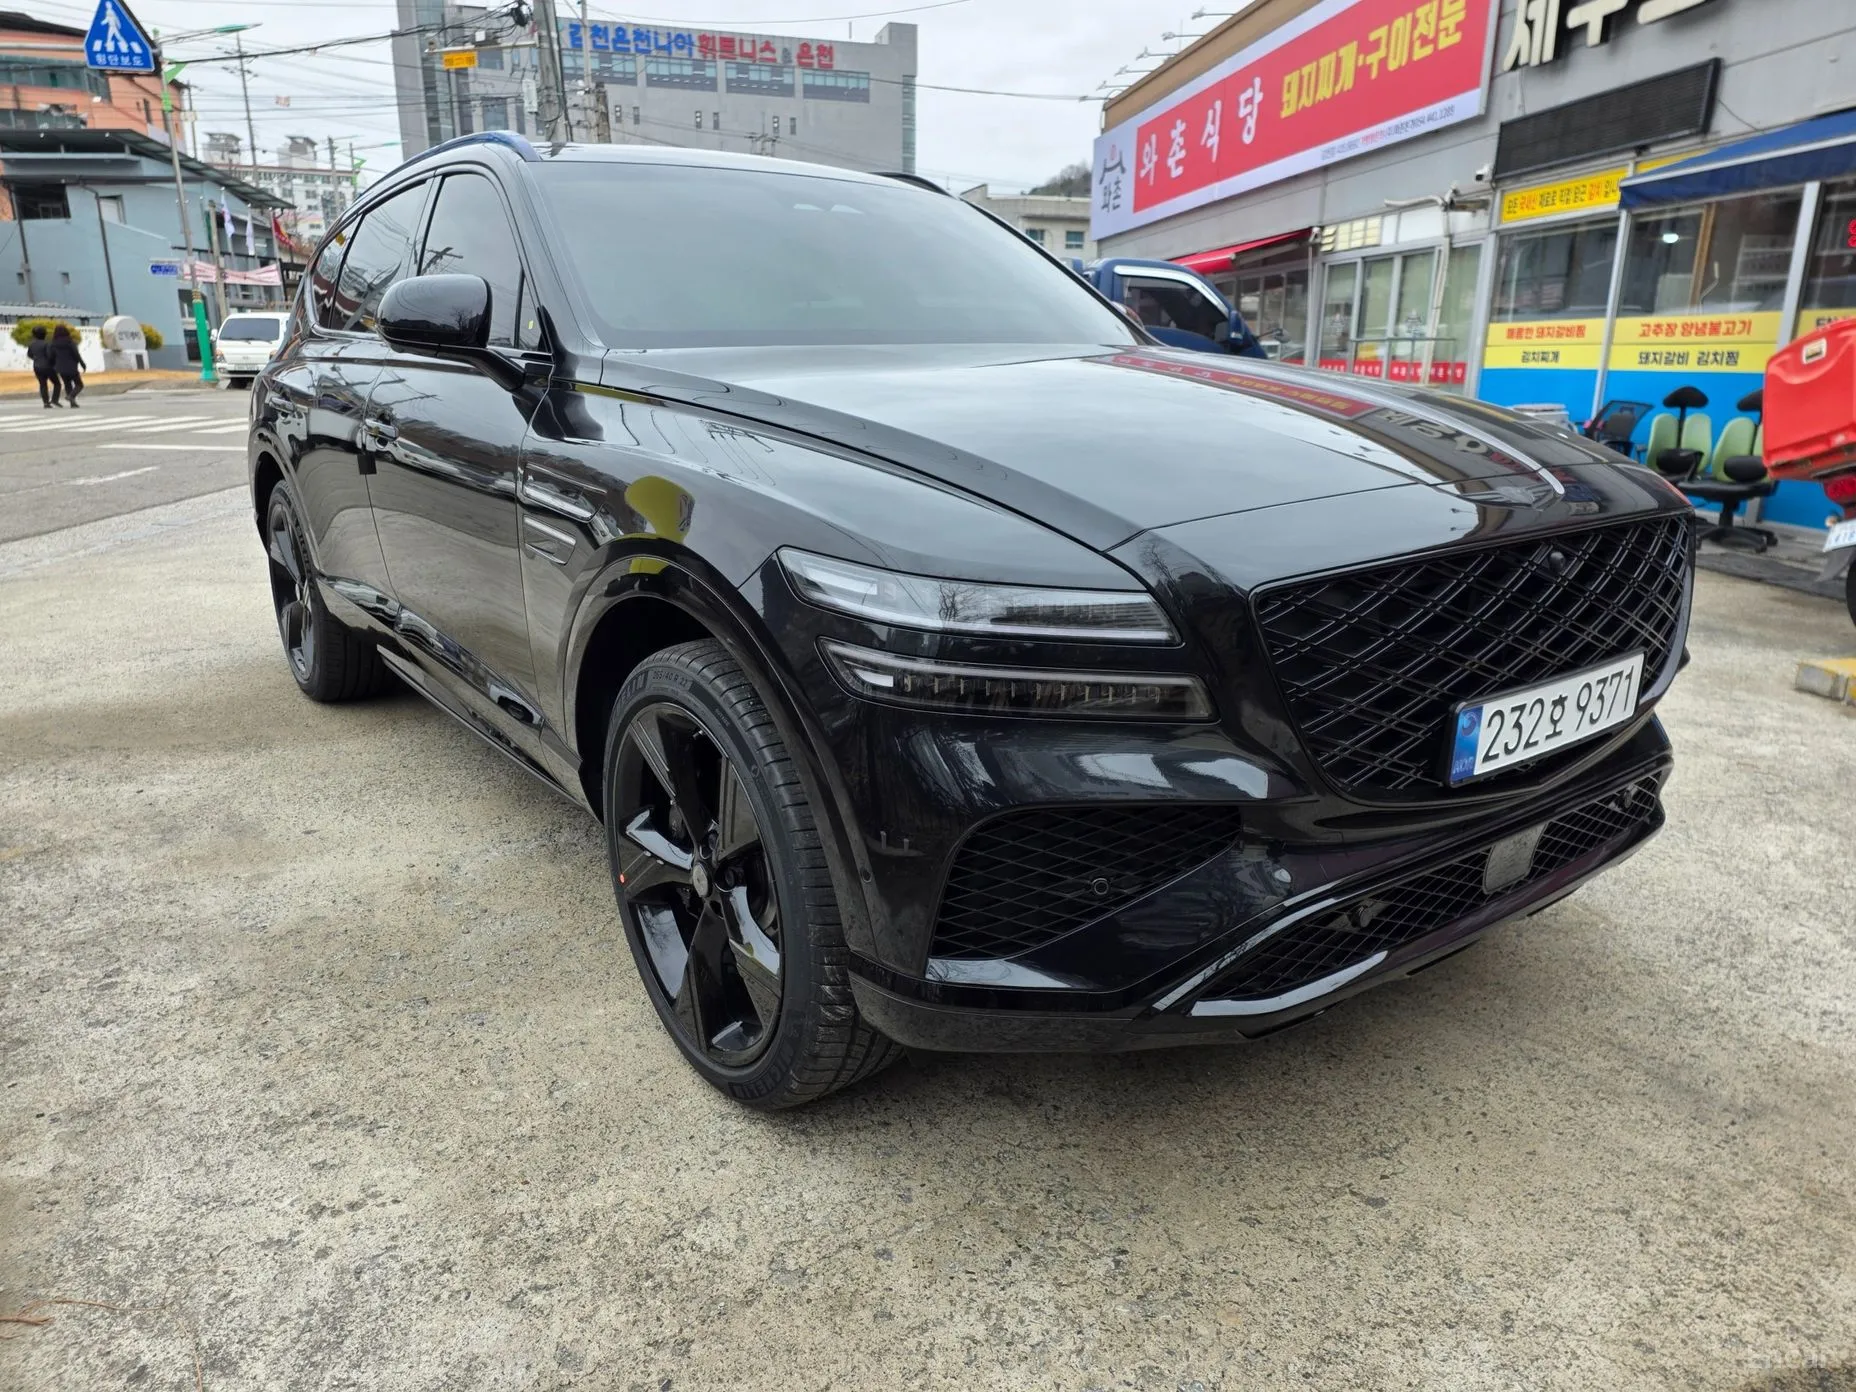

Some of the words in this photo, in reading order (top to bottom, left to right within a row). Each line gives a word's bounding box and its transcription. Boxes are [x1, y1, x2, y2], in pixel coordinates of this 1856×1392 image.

[96, 53, 144, 66] 횡단보도
[1638, 322, 1678, 337] 고추장
[1680, 319, 1752, 337] 양념불고기
[1521, 351, 1560, 363] 김치찌개
[1637, 351, 1690, 366] 돼지갈비
[1697, 350, 1740, 366] 김치찜
[1481, 694, 1568, 764] 232호
[1576, 665, 1635, 732] 9371
